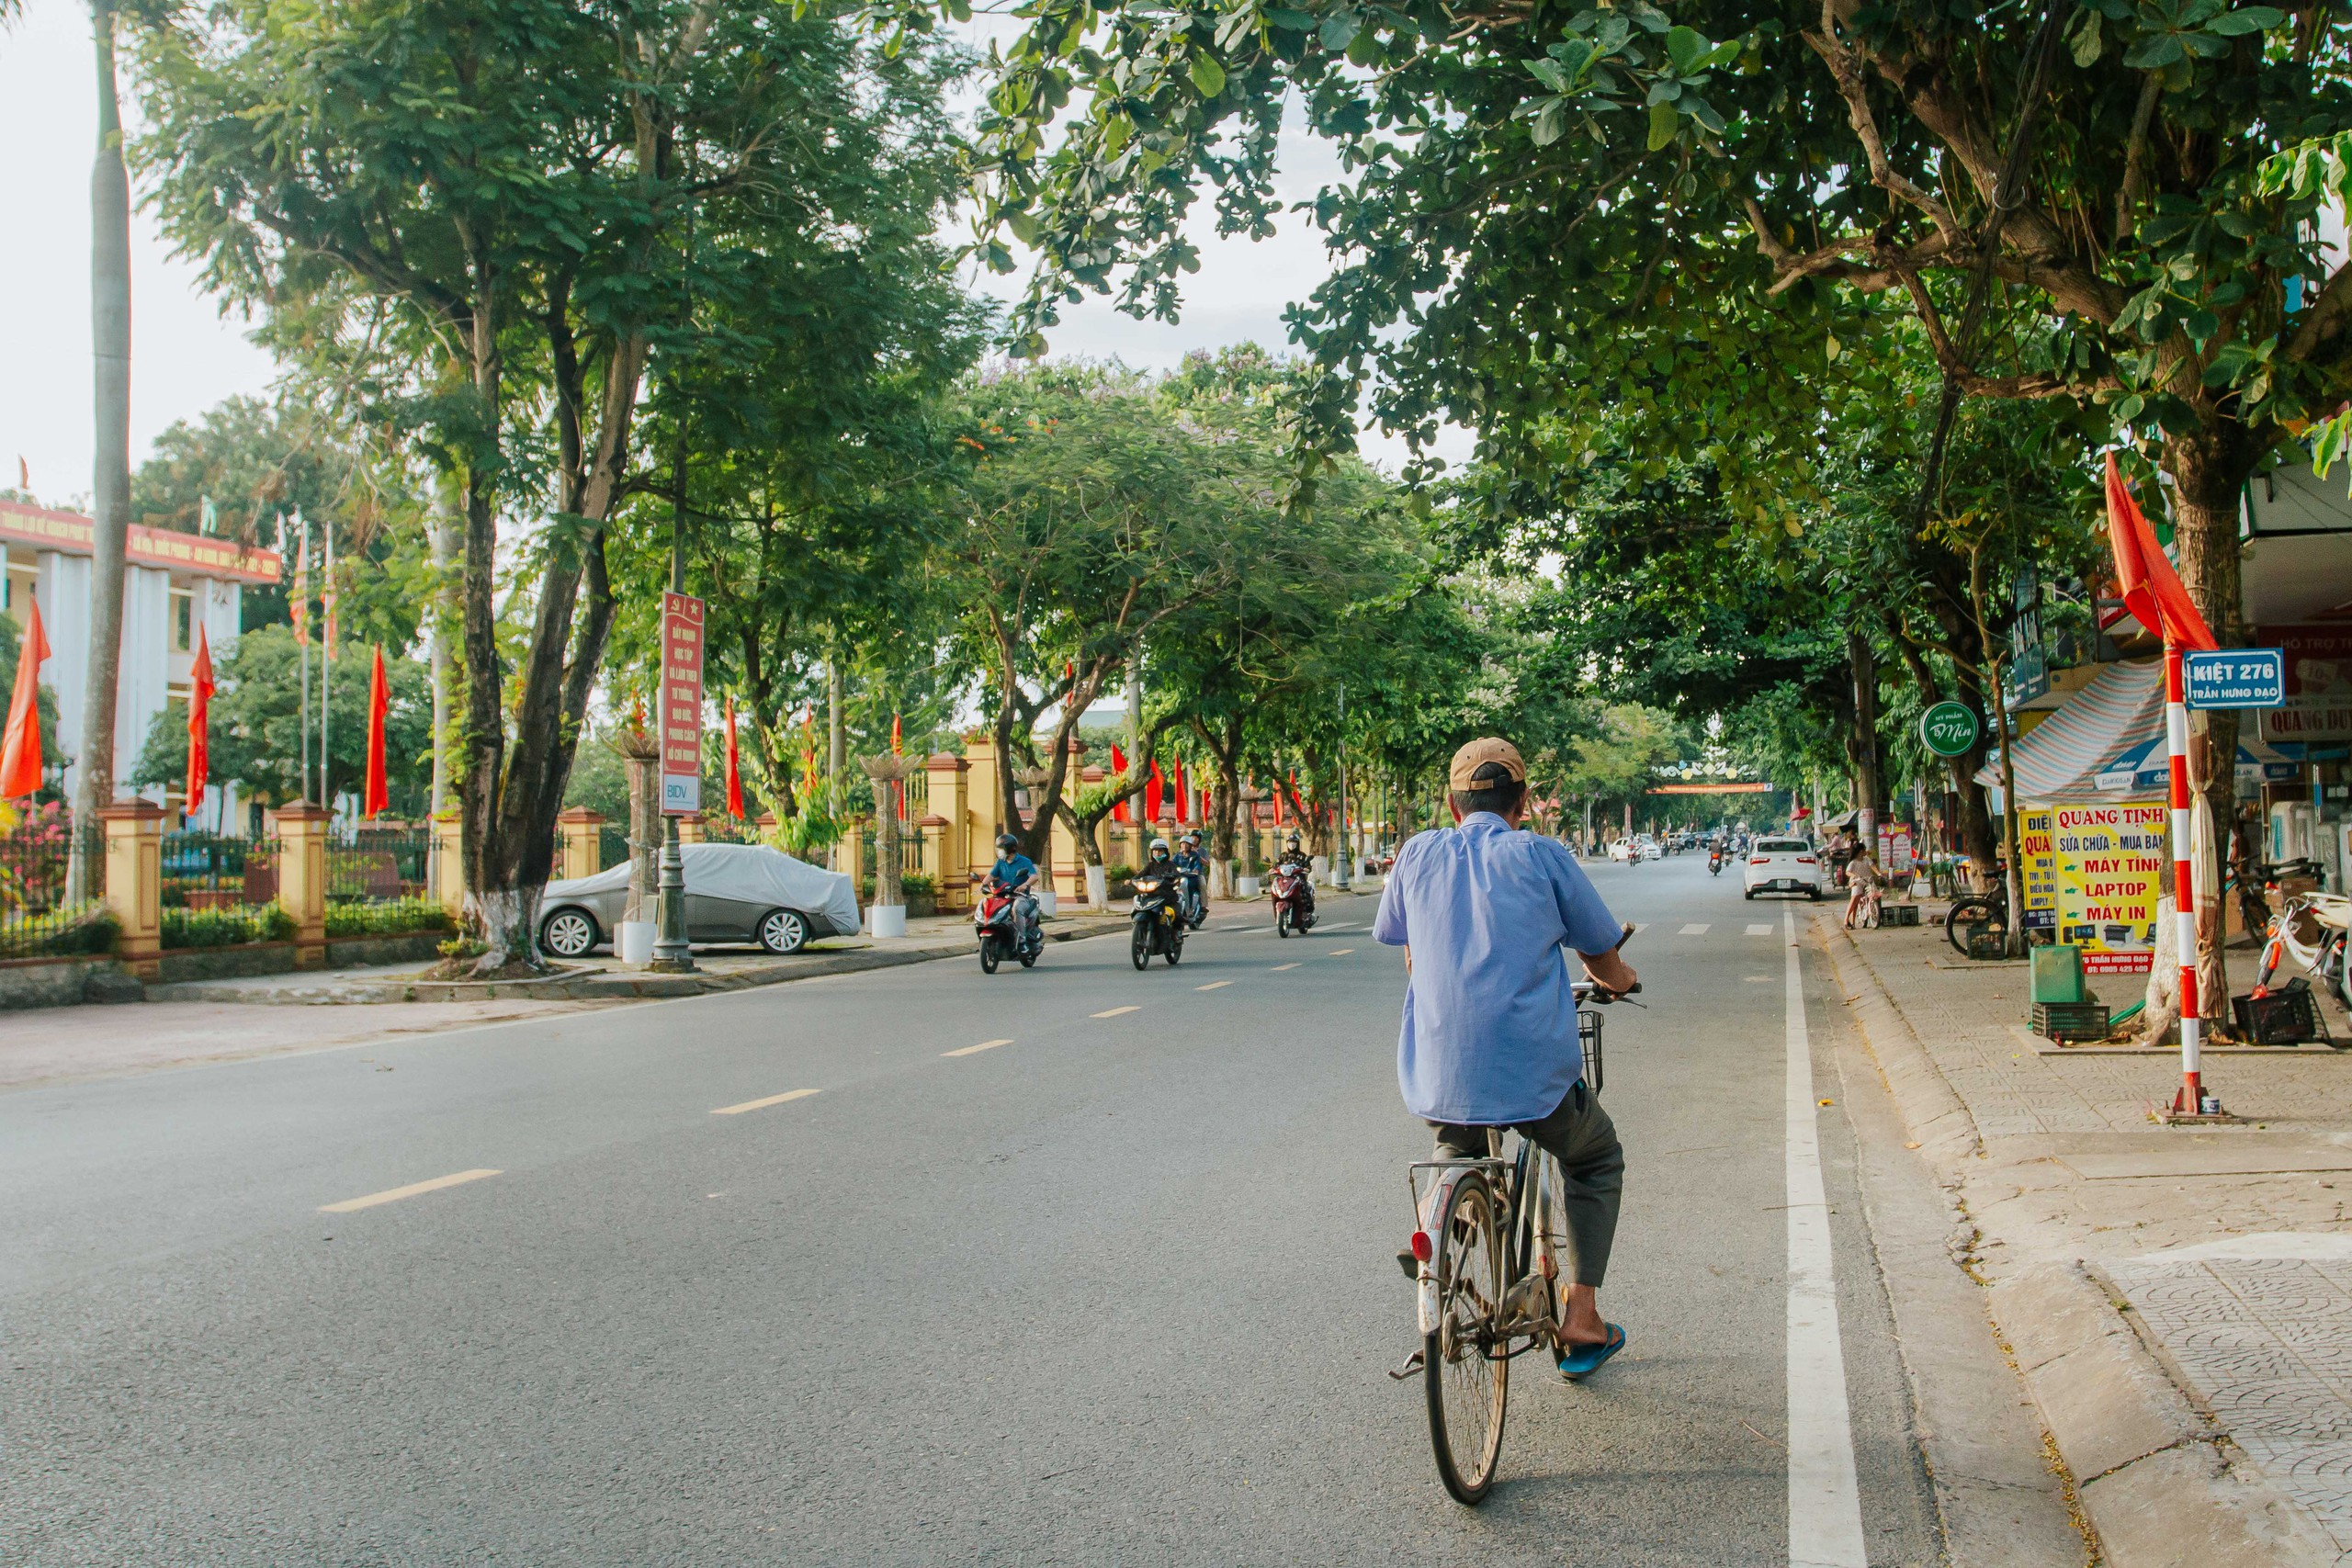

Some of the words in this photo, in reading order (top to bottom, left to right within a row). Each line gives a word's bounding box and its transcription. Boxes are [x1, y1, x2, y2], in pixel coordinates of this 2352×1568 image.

[2193, 661, 2234, 684] KIỆT
[2240, 662, 2274, 680] 276
[2192, 685, 2219, 699] TRẦN
[2221, 687, 2252, 698] HƯNG
[2254, 687, 2278, 699] ĐẠO
[667, 784, 687, 798] BIDV
[2059, 808, 2119, 829] QUANG
[2123, 808, 2165, 828] TỊNH
[2025, 835, 2052, 856] QUA
[2059, 832, 2079, 852] SỬA
[2083, 833, 2109, 852] CHỮA
[2120, 835, 2142, 850] MUA
[2085, 856, 2120, 873] MÁY
[2086, 882, 2147, 897] LAPTOP
[2086, 904, 2122, 920] MÁY
[2128, 906, 2145, 919] IN
